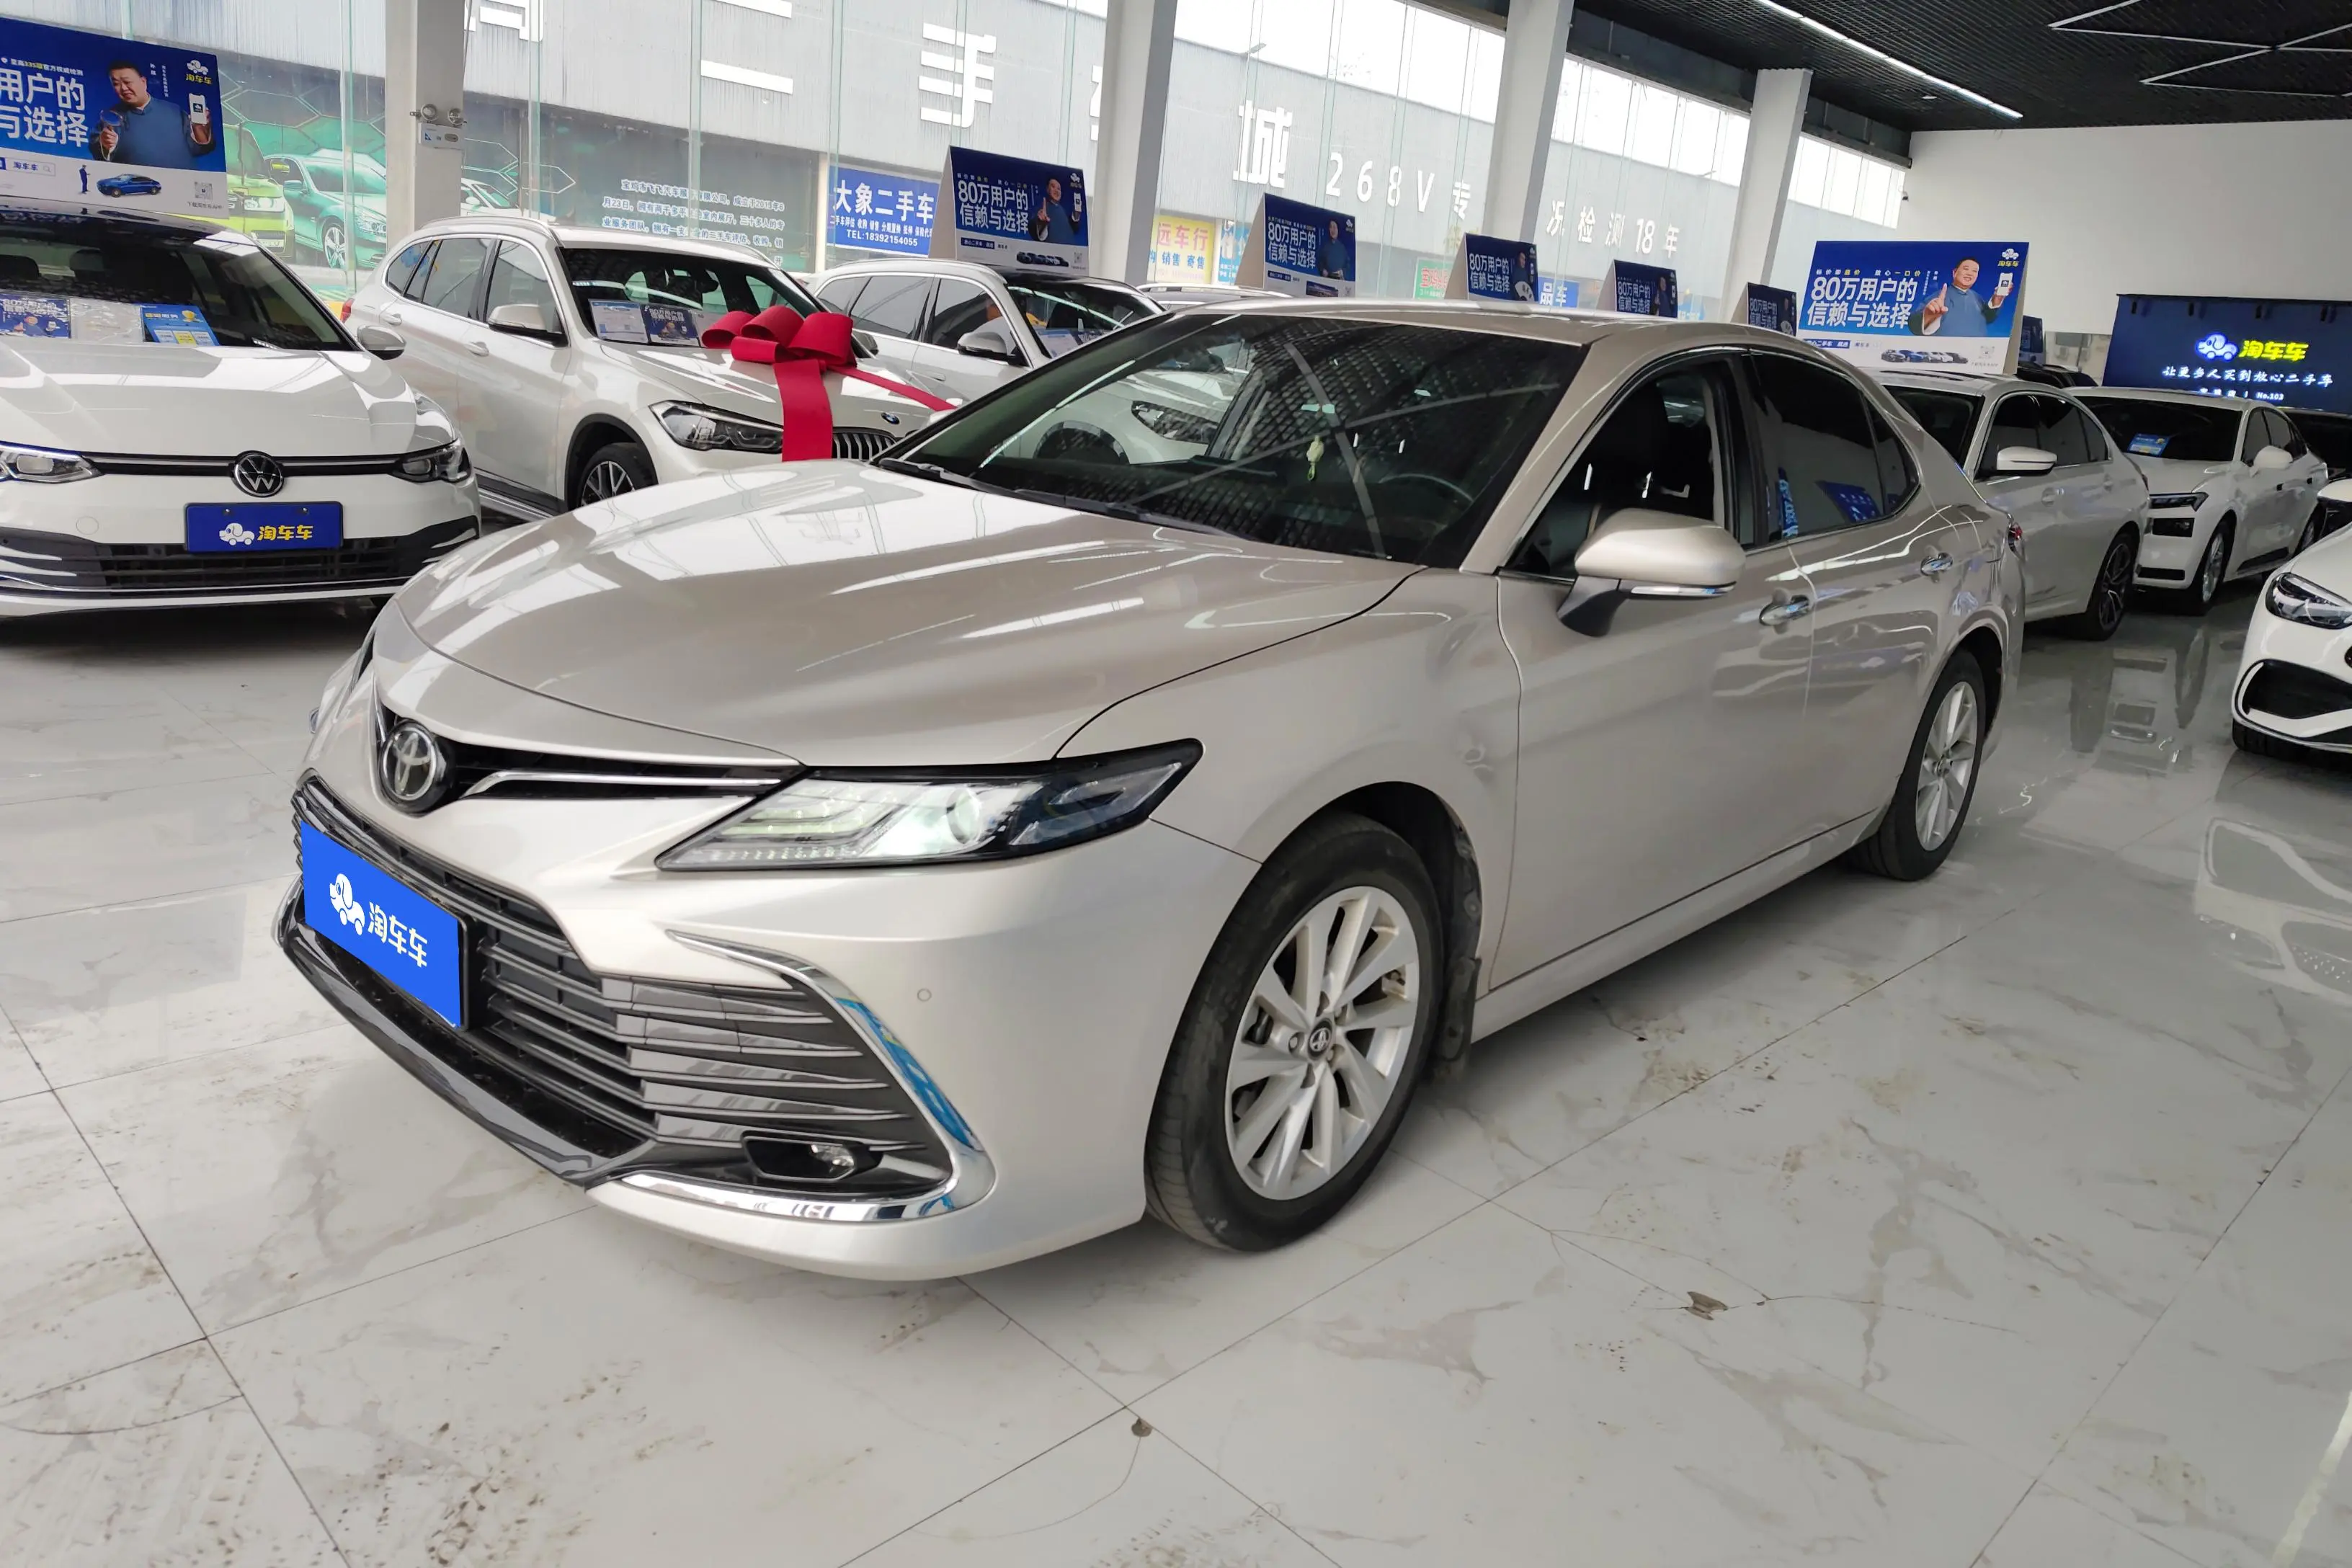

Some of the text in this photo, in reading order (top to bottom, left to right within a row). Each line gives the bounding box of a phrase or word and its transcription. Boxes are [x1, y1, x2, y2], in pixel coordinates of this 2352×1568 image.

[833, 180, 935, 225] 大象二手车
[958, 180, 1028, 211] 80万用户的
[959, 202, 1029, 234] 信赖与选择
[847, 229, 918, 246] TEL:18392154055
[1268, 221, 1316, 250] 80万用户的
[1268, 241, 1316, 270] 信赖与选择
[1469, 253, 1510, 277] 80万用户的
[1470, 271, 1510, 293] 信赖与选择
[1618, 281, 1651, 299] 80万用户的
[1811, 277, 1918, 302] 80万用户的
[1618, 295, 1651, 314] 信赖与选择
[1807, 300, 1912, 329] 信赖与选择
[2238, 339, 2309, 362] 淘车车
[2162, 365, 2334, 388] 让更多人买到放心二手车
[257, 525, 313, 541] 淘车车
